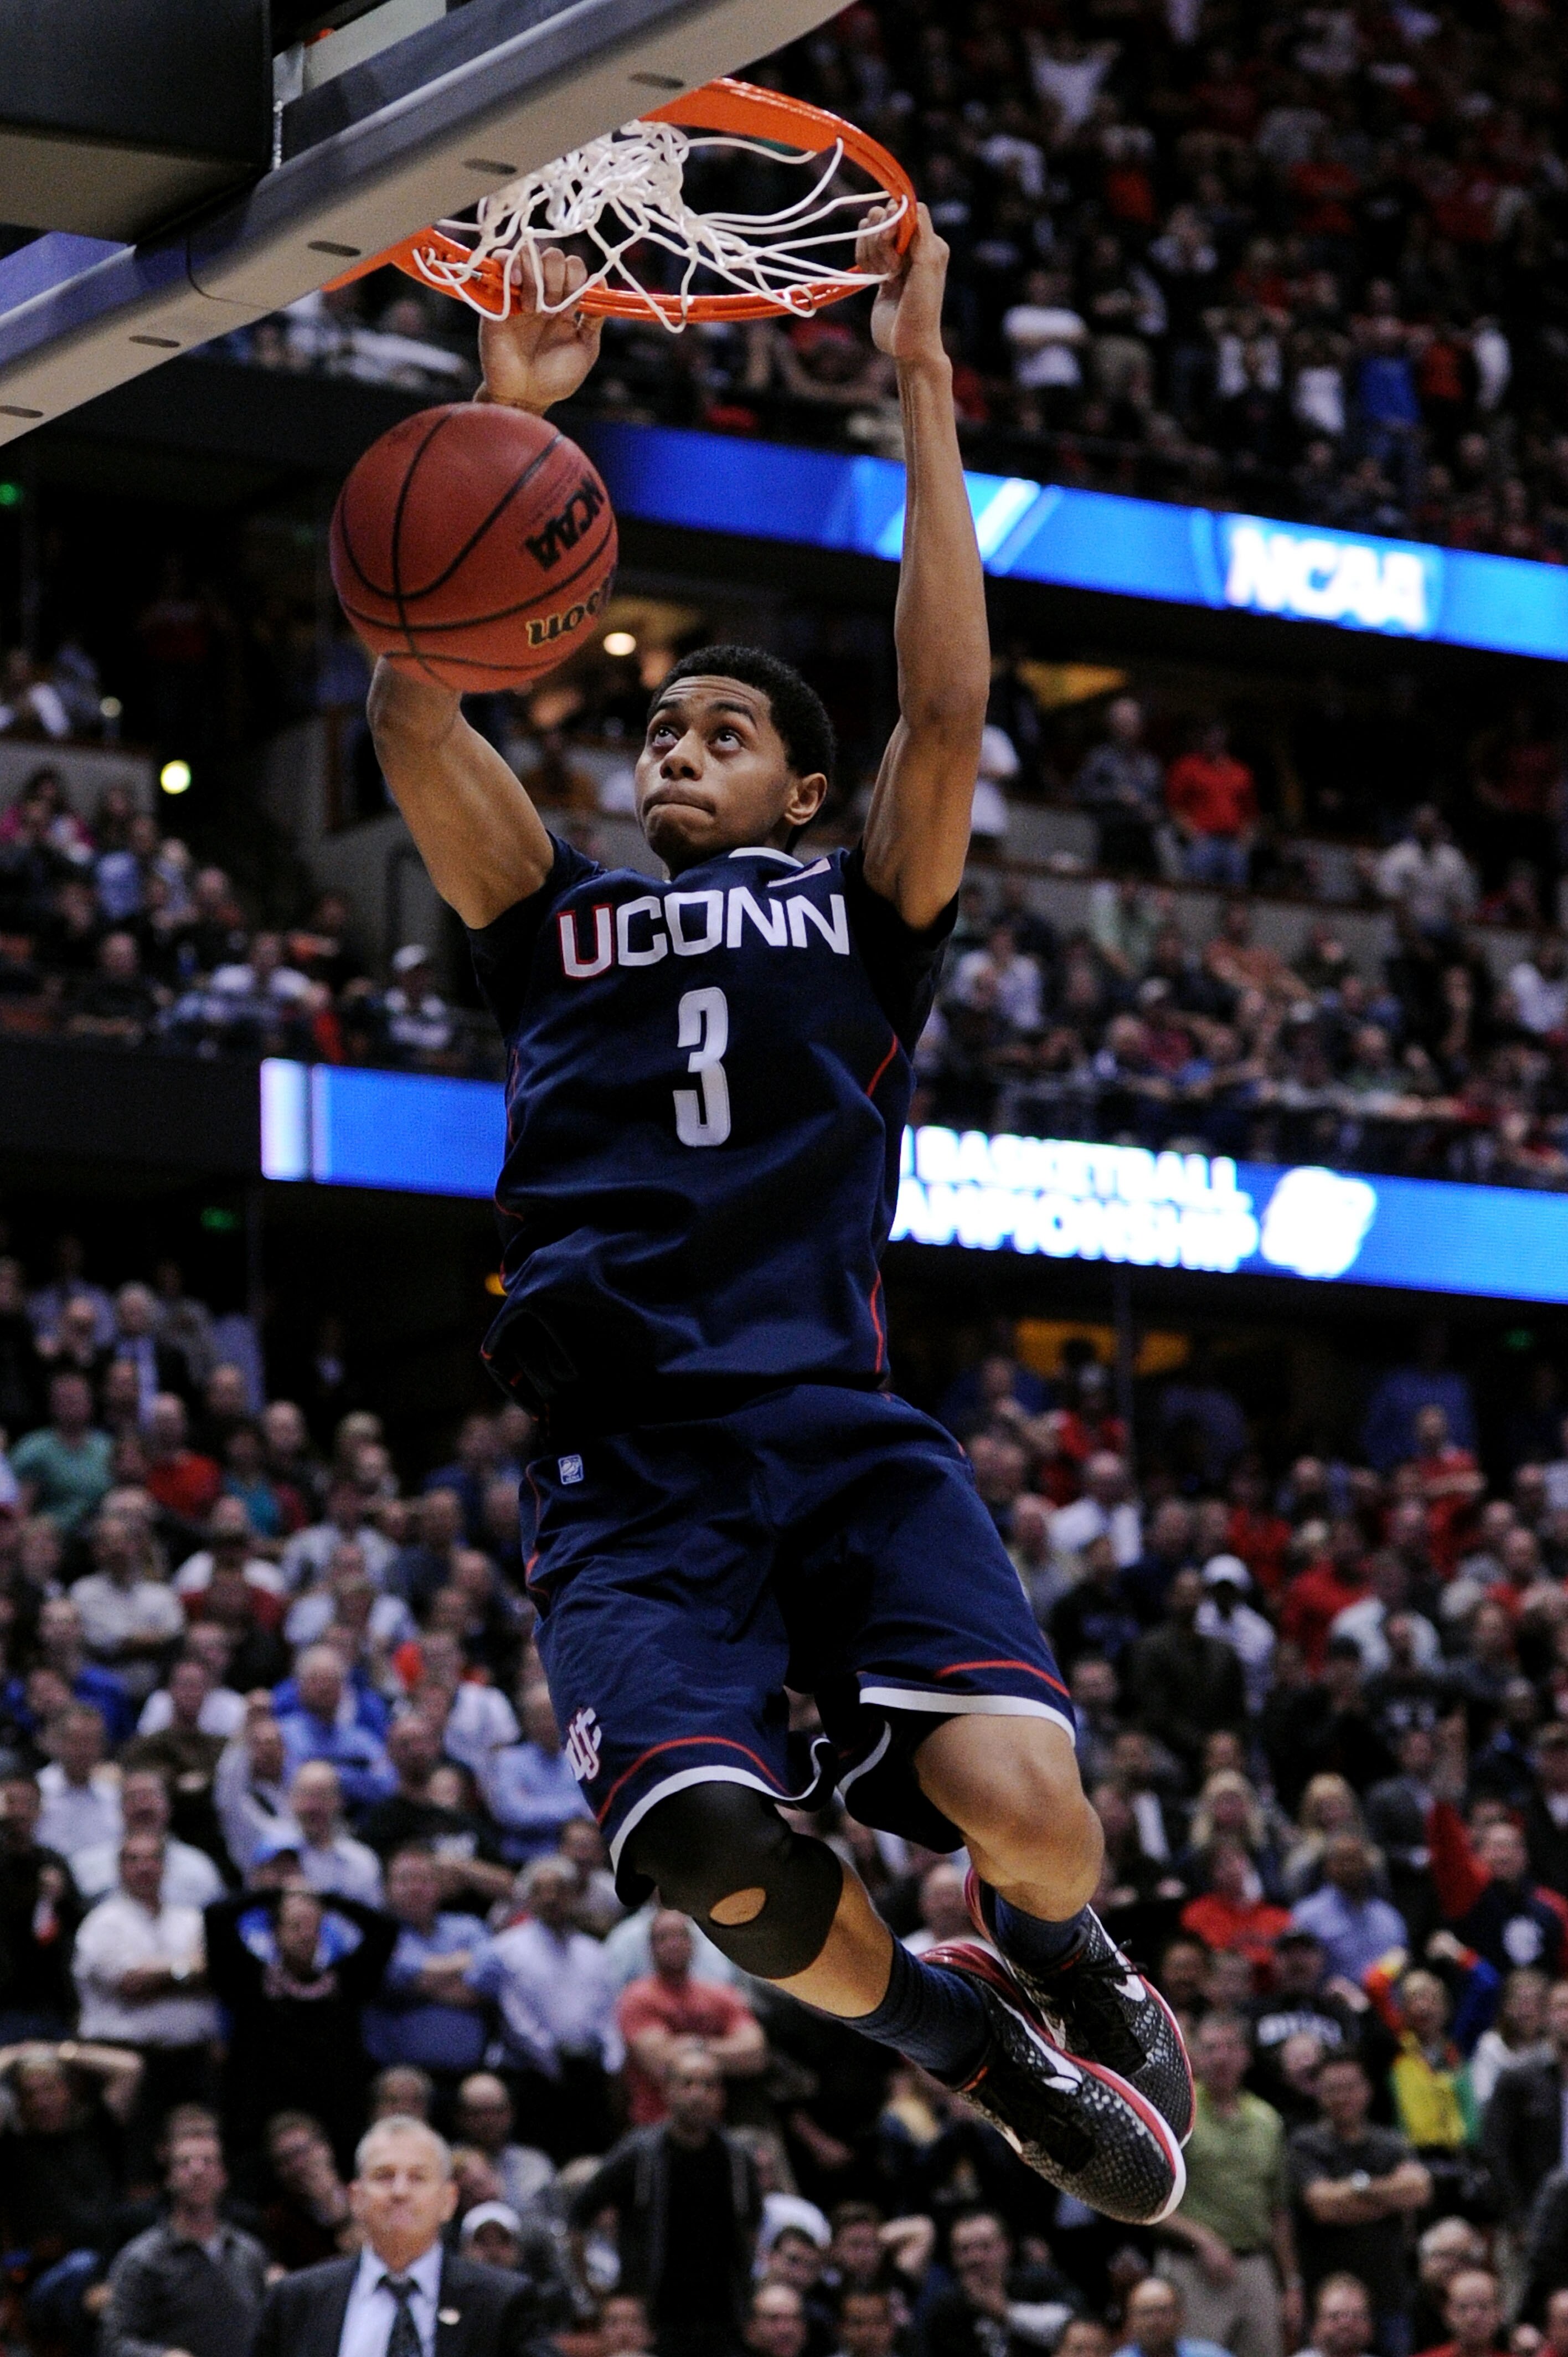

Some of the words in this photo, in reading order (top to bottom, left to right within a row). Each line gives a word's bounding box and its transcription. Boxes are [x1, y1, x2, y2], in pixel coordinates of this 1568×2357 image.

[527, 475, 605, 569] NCAA
[1226, 526, 1425, 630] NCAA
[558, 887, 850, 979] UCONN
[673, 986, 731, 1147] 3
[916, 1125, 1252, 1213] BASKETBALL
[888, 1179, 1260, 1273] AMPIONSHIP
